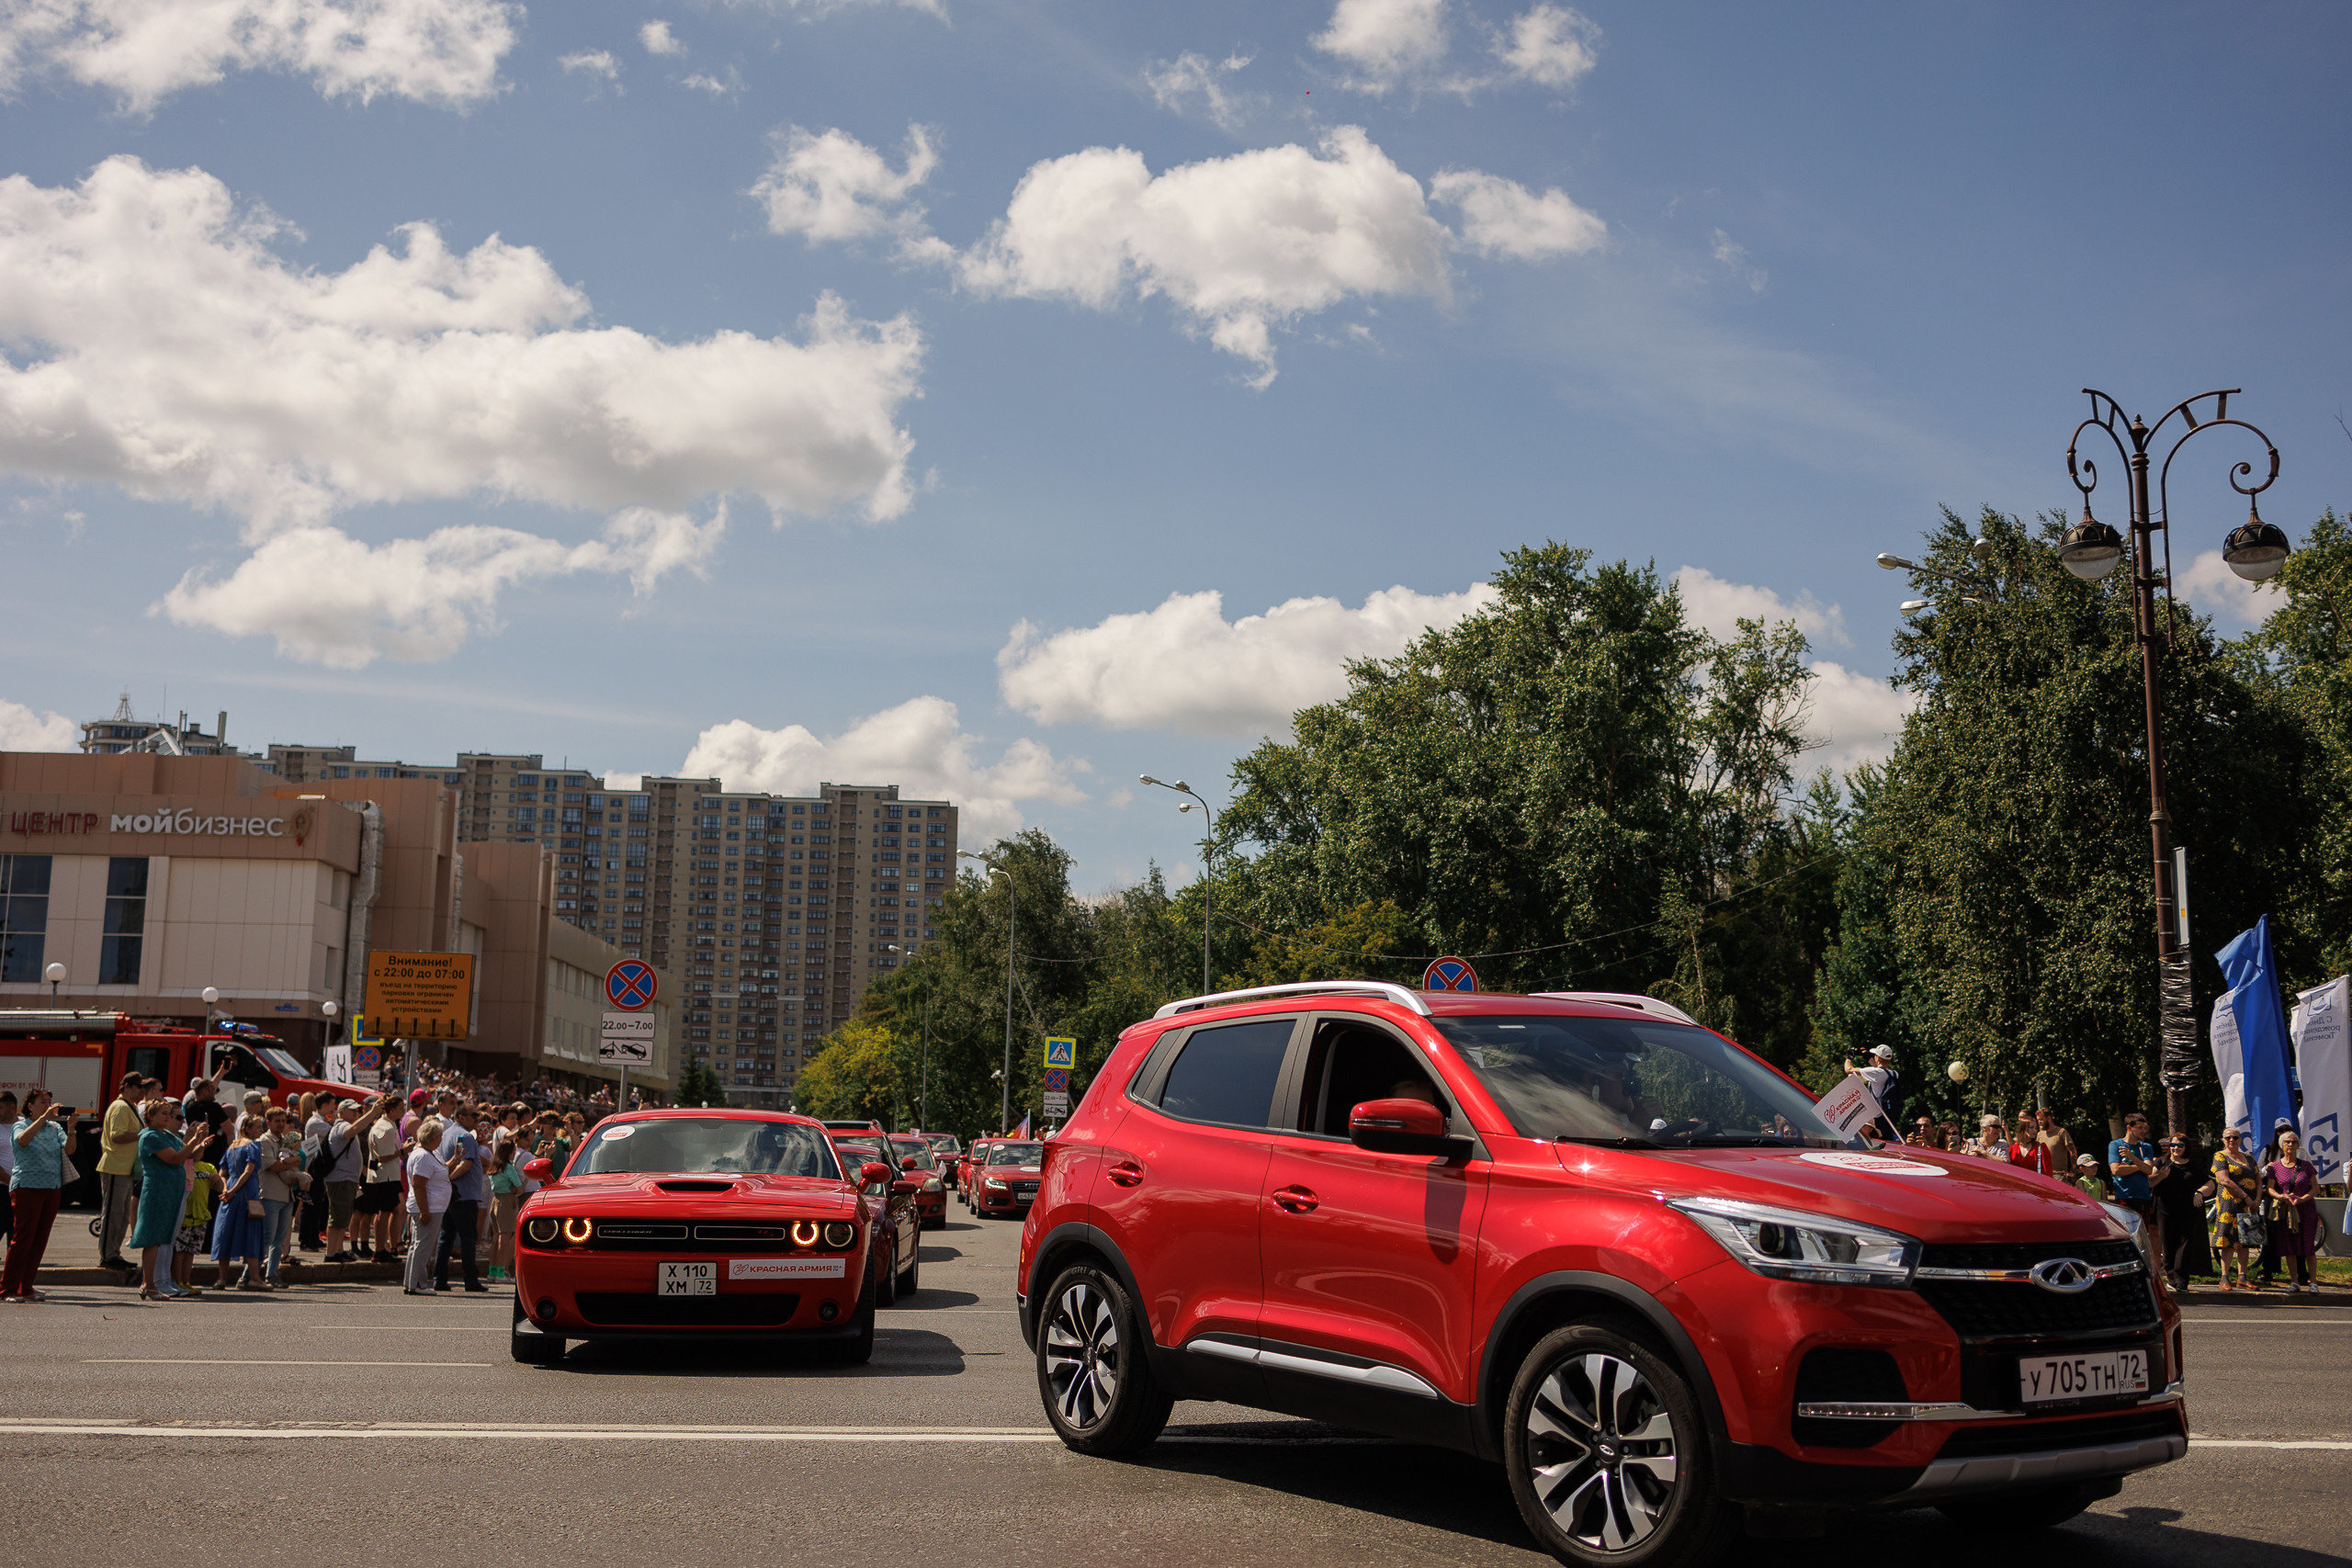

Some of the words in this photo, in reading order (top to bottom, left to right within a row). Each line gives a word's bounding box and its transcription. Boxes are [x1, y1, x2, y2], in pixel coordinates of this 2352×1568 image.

[11, 811, 99, 838] ЦЕНТР
[388, 955, 453, 967] Внимание!
[383, 967, 414, 977] 22:00
[416, 970, 432, 980] до
[435, 969, 465, 979] 07:00
[1836, 1089, 1861, 1111] КРАСНАЯ
[1839, 1099, 1858, 1115] АРМИЯ
[668, 1265, 677, 1277] Х
[683, 1265, 707, 1277] 110
[666, 1280, 687, 1293] ХМ
[698, 1280, 712, 1291] 72
[2120, 1354, 2141, 1380] 72
[2120, 1380, 2135, 1390] RUS
